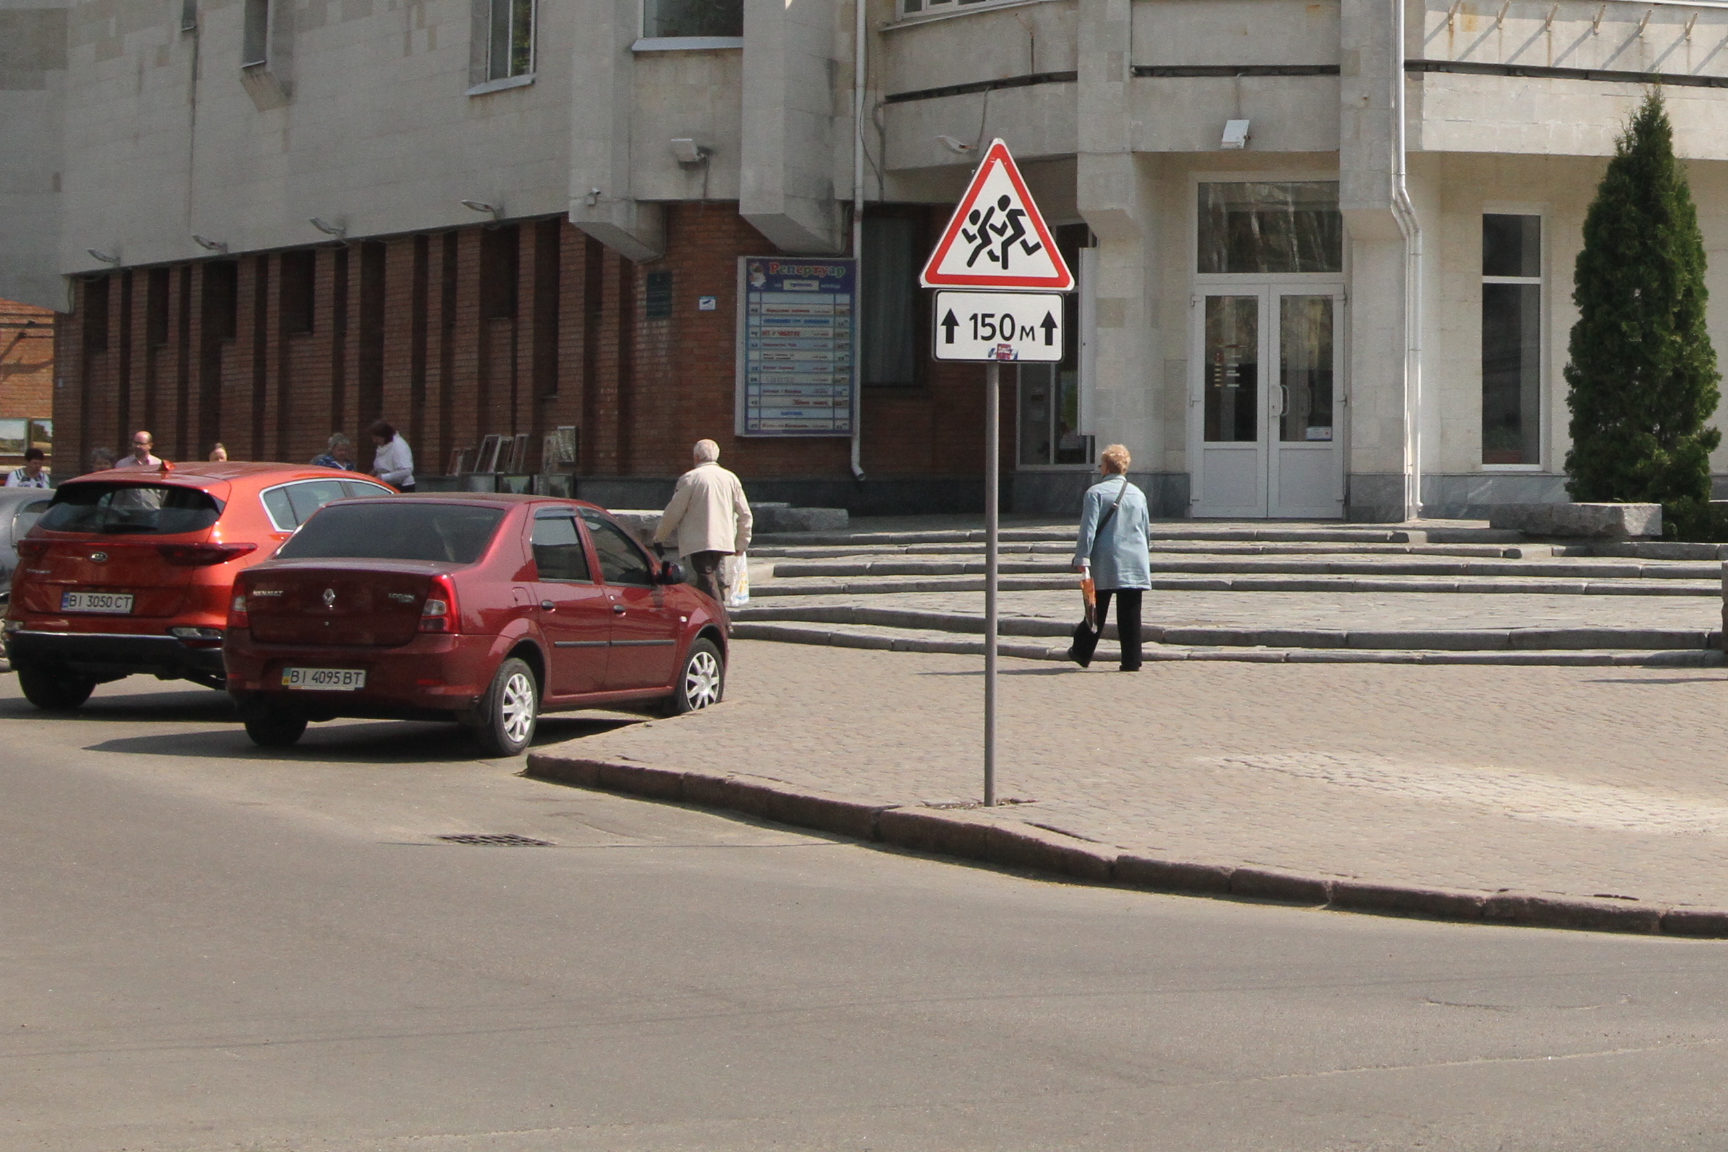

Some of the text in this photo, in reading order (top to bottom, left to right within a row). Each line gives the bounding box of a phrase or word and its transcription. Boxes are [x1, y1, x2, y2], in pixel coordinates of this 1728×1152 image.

[769, 262, 846, 278] Репертуар
[968, 312, 1016, 342] 150
[69, 594, 132, 609] BI 3050 CT
[290, 670, 362, 685] BI 4095 BT
